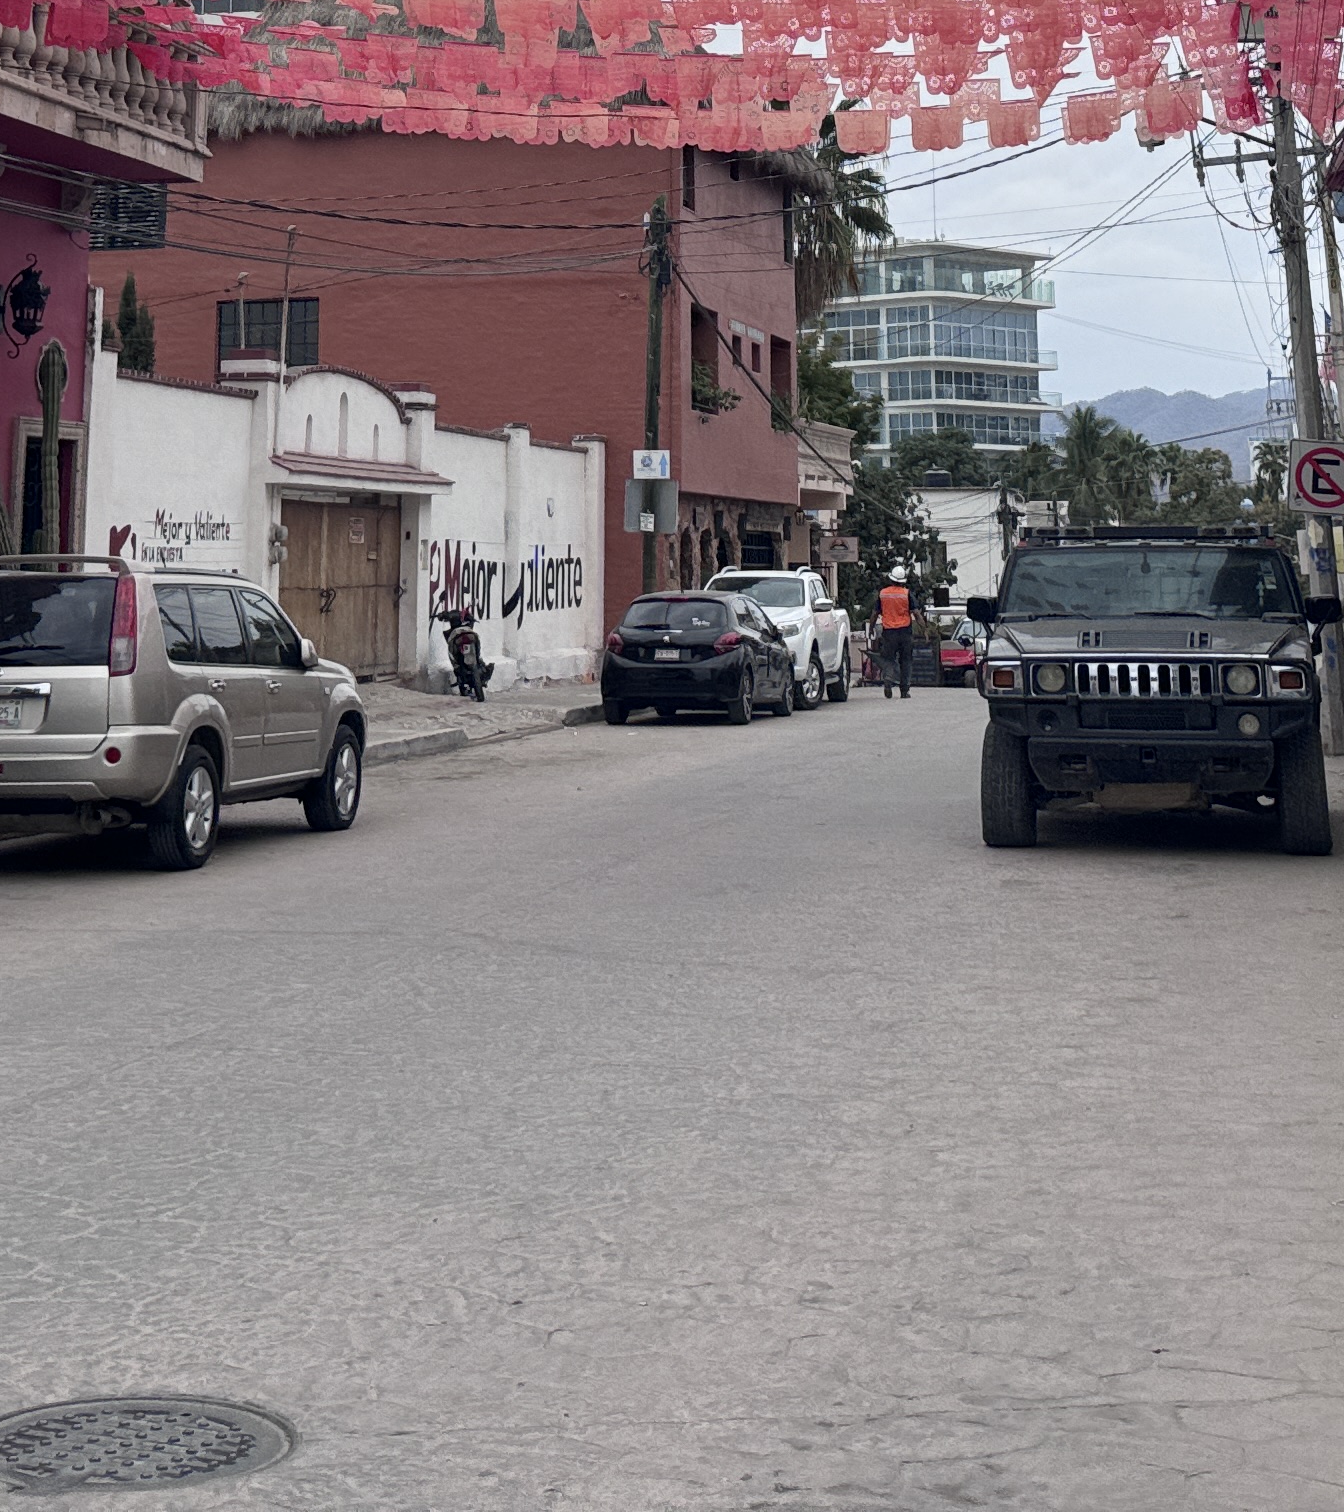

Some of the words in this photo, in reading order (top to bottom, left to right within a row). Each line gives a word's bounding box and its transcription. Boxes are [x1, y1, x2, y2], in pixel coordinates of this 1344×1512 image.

[1312, 458, 1340, 495] E
[154, 507, 183, 545] Mejor
[194, 510, 230, 541] Valiente
[445, 539, 497, 620] Mejor
